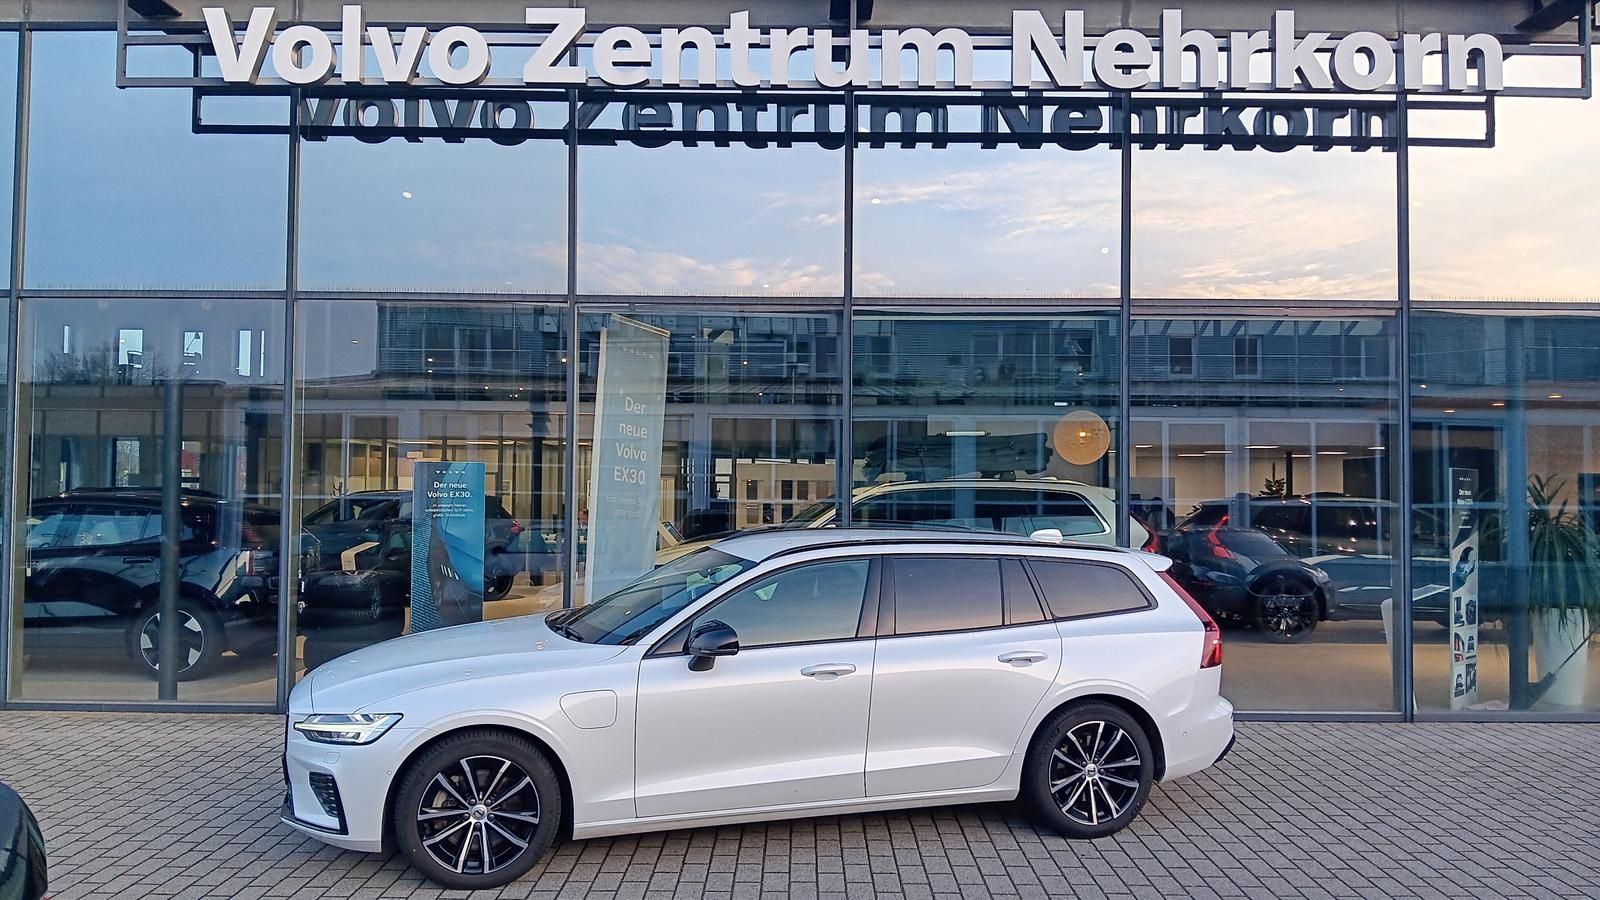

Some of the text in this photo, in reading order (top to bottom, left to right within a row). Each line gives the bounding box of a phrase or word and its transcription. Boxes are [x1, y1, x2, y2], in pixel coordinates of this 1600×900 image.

[202, 5, 1503, 91] Volvo Zentrum Nehrkorn
[624, 396, 647, 414] Der
[619, 422, 648, 438] neue
[615, 441, 647, 461] Volvo
[434, 481, 448, 489] Der
